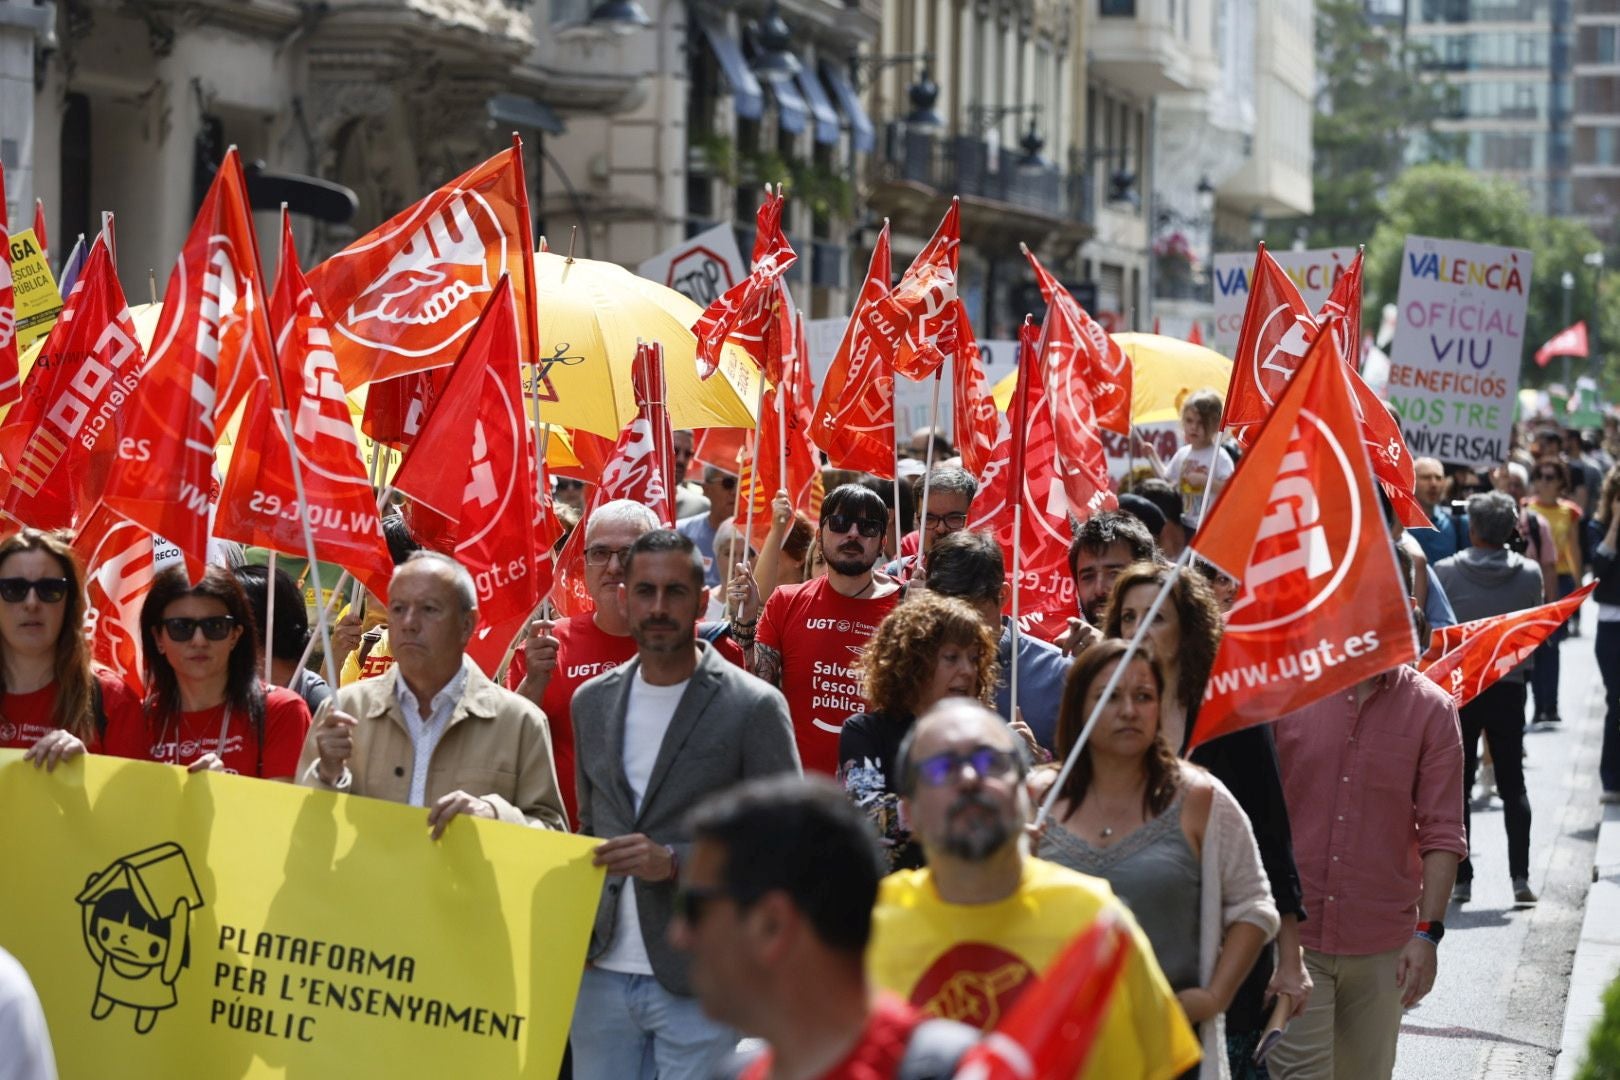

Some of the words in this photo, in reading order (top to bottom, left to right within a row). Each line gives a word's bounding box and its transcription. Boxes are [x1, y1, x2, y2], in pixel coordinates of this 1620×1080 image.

[11, 238, 37, 264] GA
[1406, 298, 1519, 338] OFICIAL
[1431, 333, 1492, 370] VIU
[1402, 424, 1505, 463] NIVERSAL
[806, 618, 836, 630] UGT
[567, 662, 601, 678] UGT
[812, 693, 867, 713] pública
[218, 924, 416, 983] PLATAFORMA
[210, 996, 317, 1043] PÚBLIC
[214, 962, 267, 996] PER
[280, 973, 526, 1042] L'ENSENYAMENT
